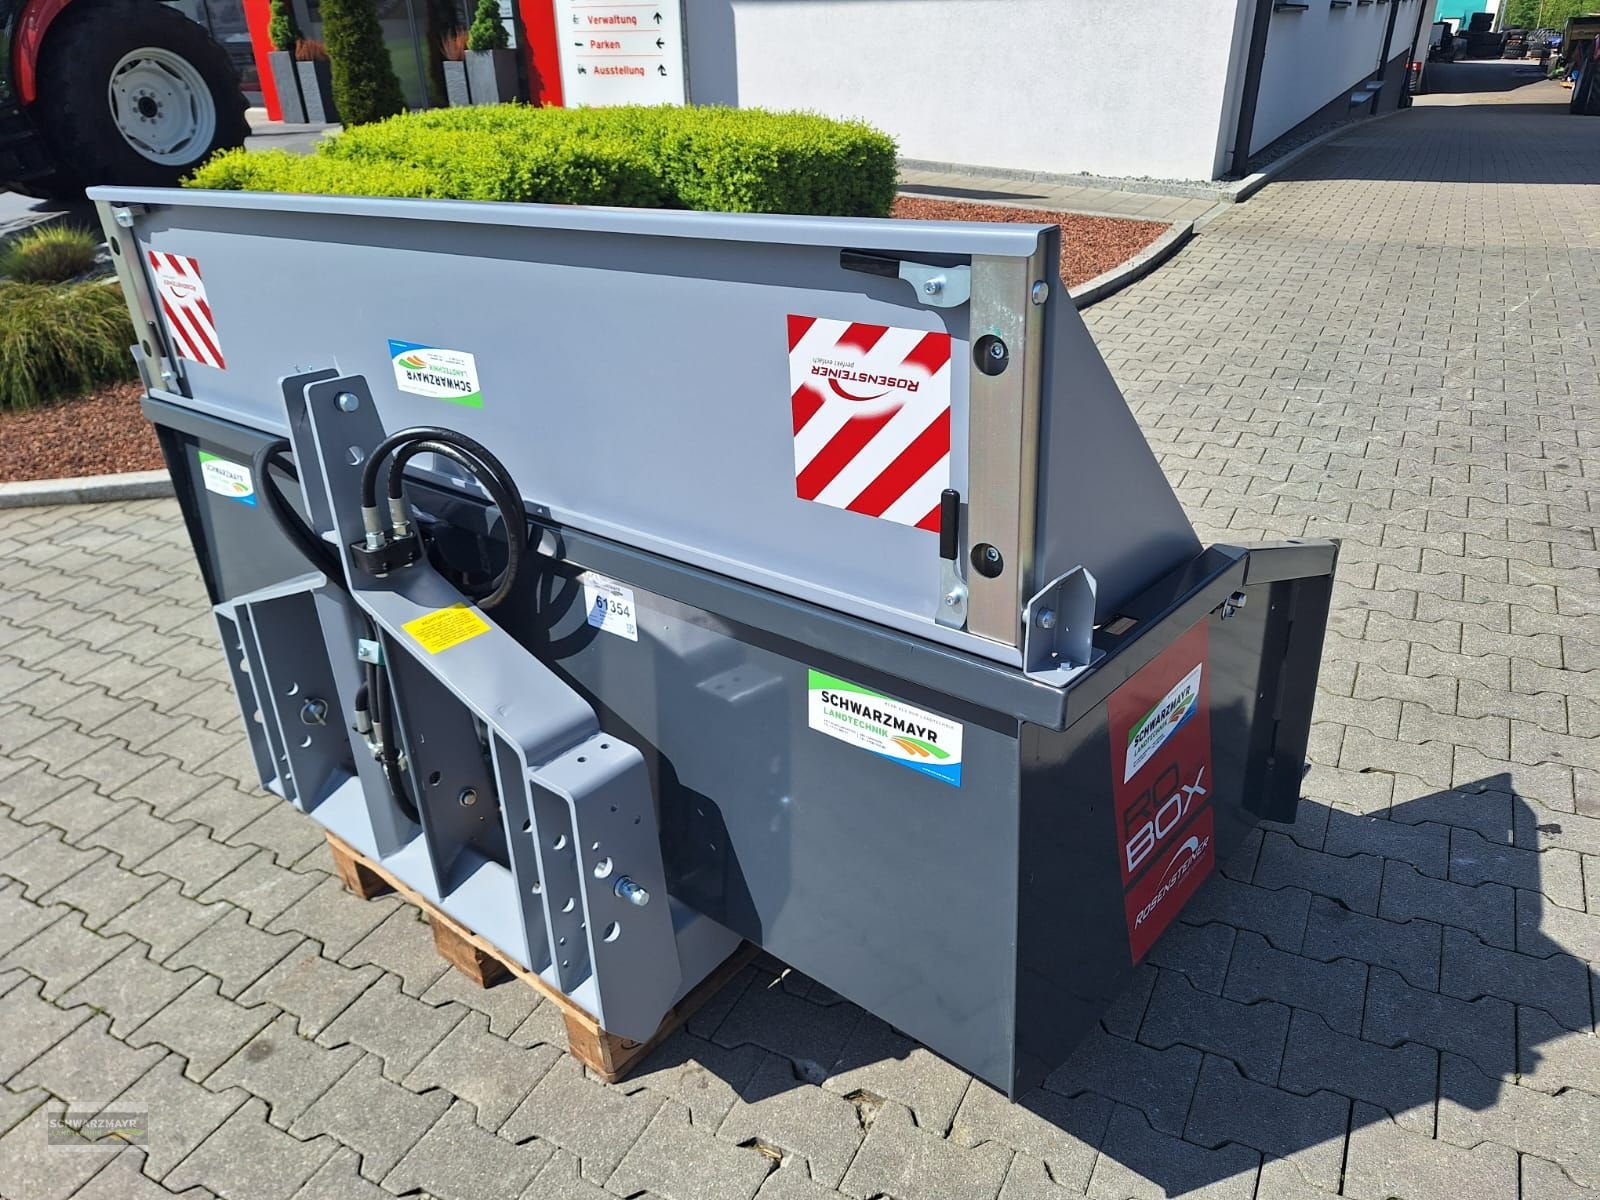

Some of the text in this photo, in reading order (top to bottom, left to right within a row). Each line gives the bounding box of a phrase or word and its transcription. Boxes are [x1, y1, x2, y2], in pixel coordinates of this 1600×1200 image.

[587, 15, 637, 25] Verwaltung
[590, 39, 621, 49] Parken
[593, 65, 645, 76] Ausstellung
[406, 369, 472, 393] SCHWARZMAYR
[811, 366, 920, 392] ROSENSTEINER
[595, 594, 630, 618] 61354
[821, 690, 938, 743] SCHWARZMAYR
[823, 706, 889, 738] LANDTECHNIK
[1134, 685, 1191, 748] SCHWARZMAYR
[1134, 836, 1209, 930] ROSENSTEINER
